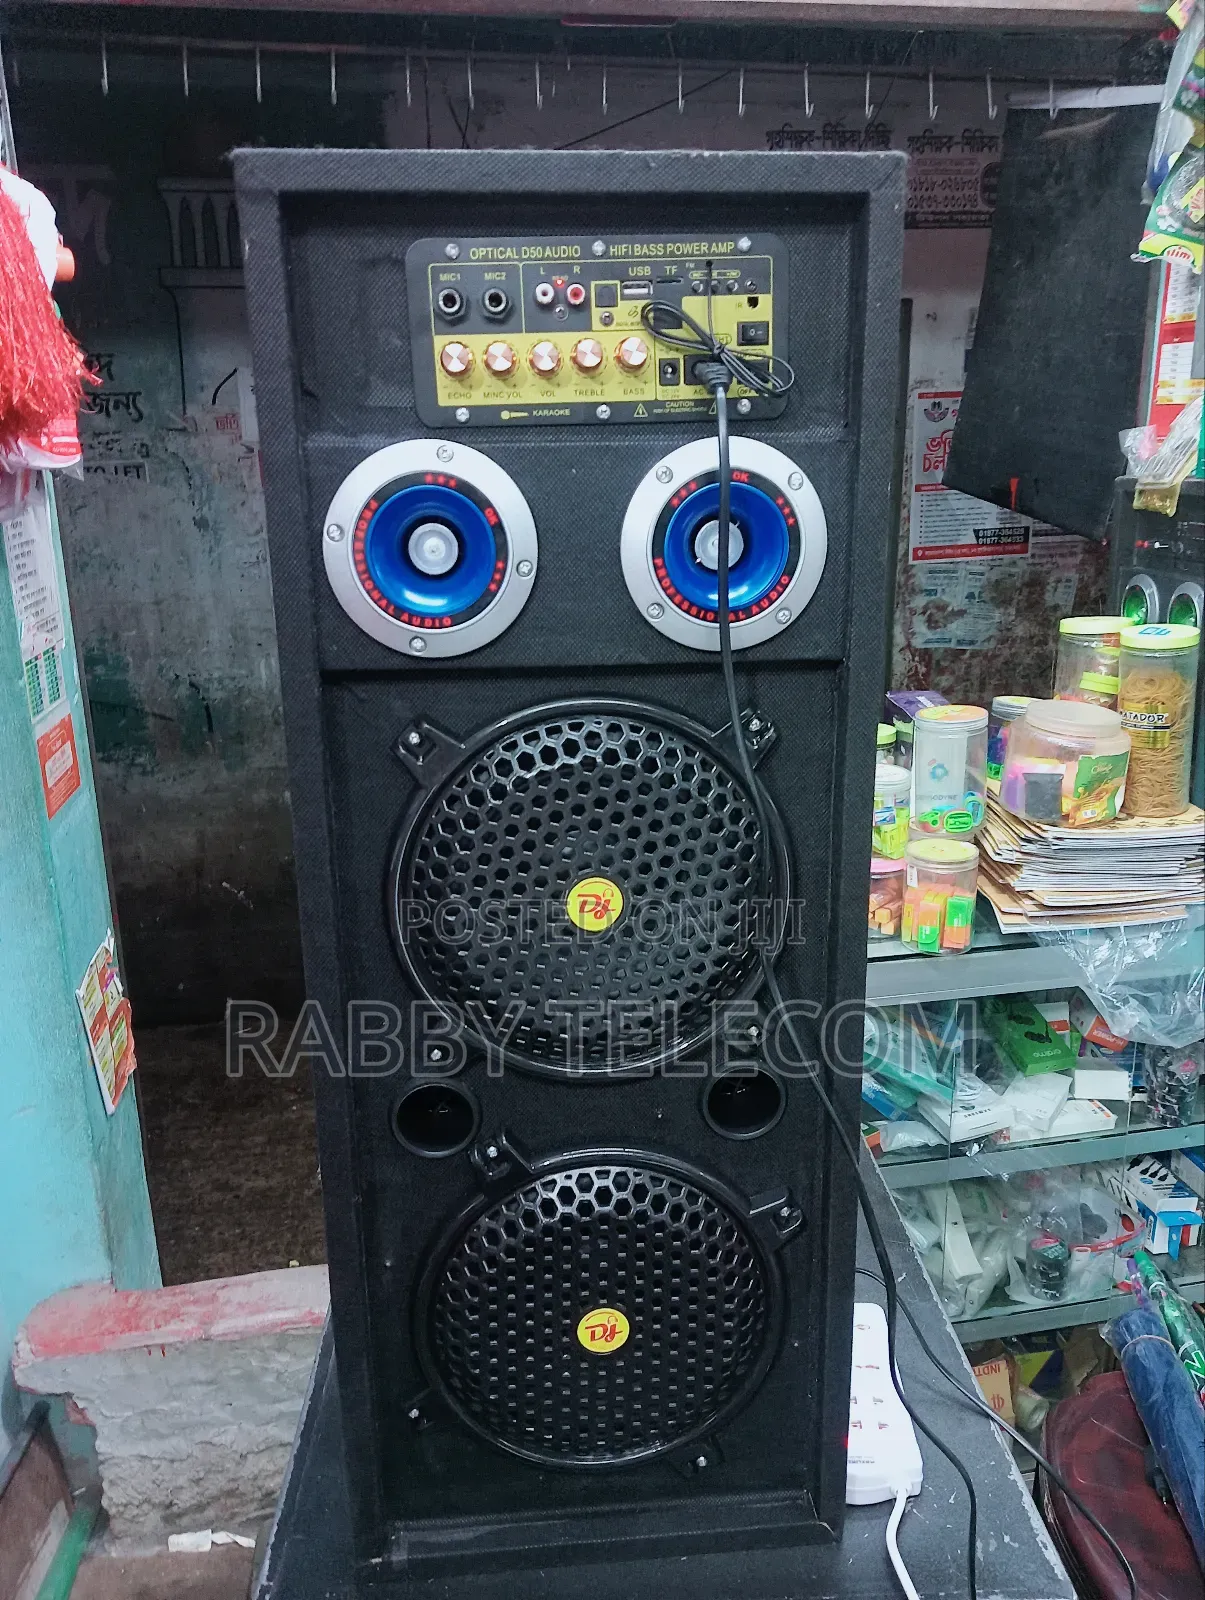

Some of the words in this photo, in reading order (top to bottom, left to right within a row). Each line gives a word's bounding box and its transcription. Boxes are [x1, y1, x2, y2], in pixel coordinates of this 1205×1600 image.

[470, 247, 519, 260] OPTICAL
[521, 246, 543, 258] D50
[545, 245, 581, 258] AUDIO
[610, 244, 632, 256] HIFI
[634, 243, 665, 256] BASS
[666, 242, 710, 255] POWER
[710, 241, 735, 254] AMP
[540, 266, 546, 275] L
[573, 265, 581, 274] R
[628, 266, 652, 276] USB
[665, 265, 678, 275] TF
[440, 273, 461, 281] MIC1
[484, 272, 507, 280] MIC2
[447, 391, 472, 399] ECHO
[540, 390, 556, 398] VOL
[574, 389, 605, 397] TREBLE
[623, 387, 645, 396] BASS
[533, 409, 570, 417] KARAOKE
[732, 470, 750, 482] OK
[653, 556, 746, 623] PROFESSIOAL
[751, 574, 791, 615] AUDIO
[400, 612, 453, 629] AUDIO
